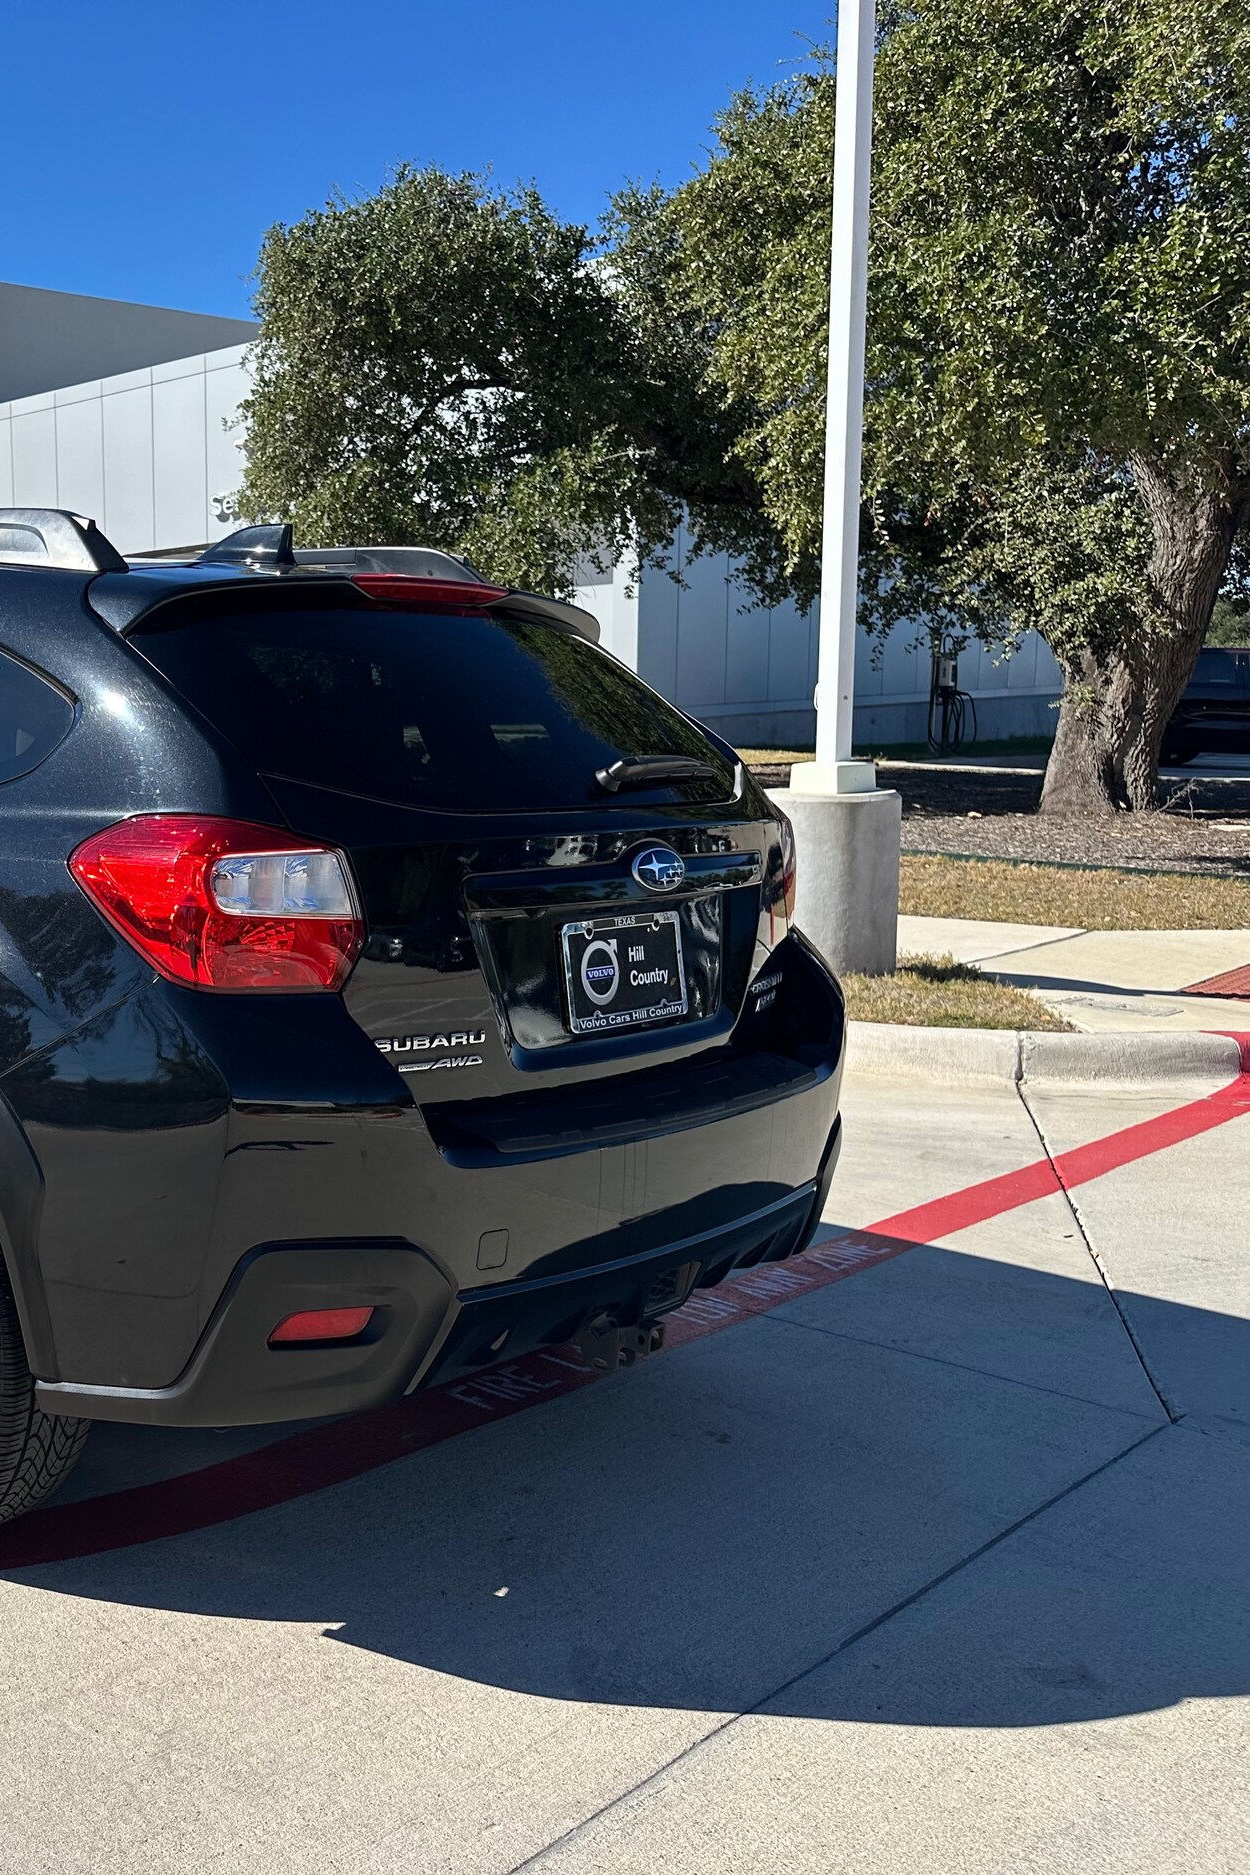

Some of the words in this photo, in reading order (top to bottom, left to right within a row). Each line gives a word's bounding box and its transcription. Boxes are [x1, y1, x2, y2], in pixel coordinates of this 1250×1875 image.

[614, 916, 636, 926] TEXAS
[628, 945, 645, 962] Hill
[587, 968, 615, 979] VOLVO
[630, 967, 668, 986] Country
[580, 1017, 607, 1029] Volvo
[609, 1014, 631, 1024] Cars
[632, 1011, 647, 1020] Hill
[649, 1004, 683, 1016] Country
[374, 1030, 486, 1053] SUBARU
[431, 1055, 483, 1070] AWD
[447, 1364, 564, 1412] FIRE
